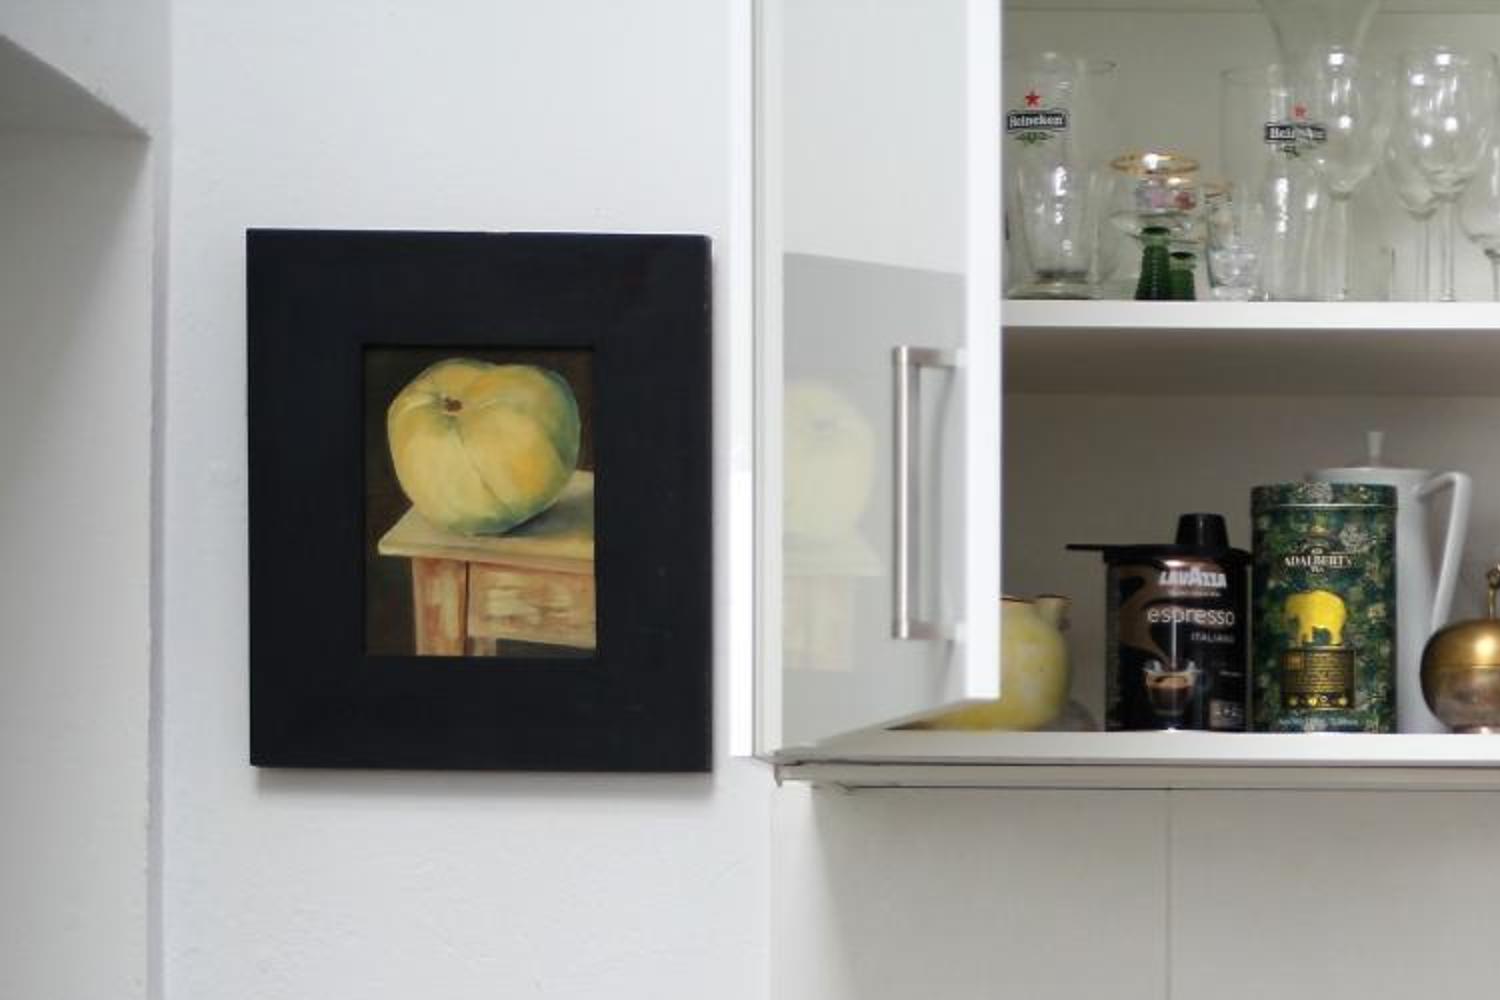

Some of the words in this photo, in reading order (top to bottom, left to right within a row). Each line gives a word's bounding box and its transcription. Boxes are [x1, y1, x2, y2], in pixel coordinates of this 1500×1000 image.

[1009, 113, 1063, 128] Heineken
[1269, 127, 1324, 139] Hein
[1147, 607, 1235, 627] espresso
